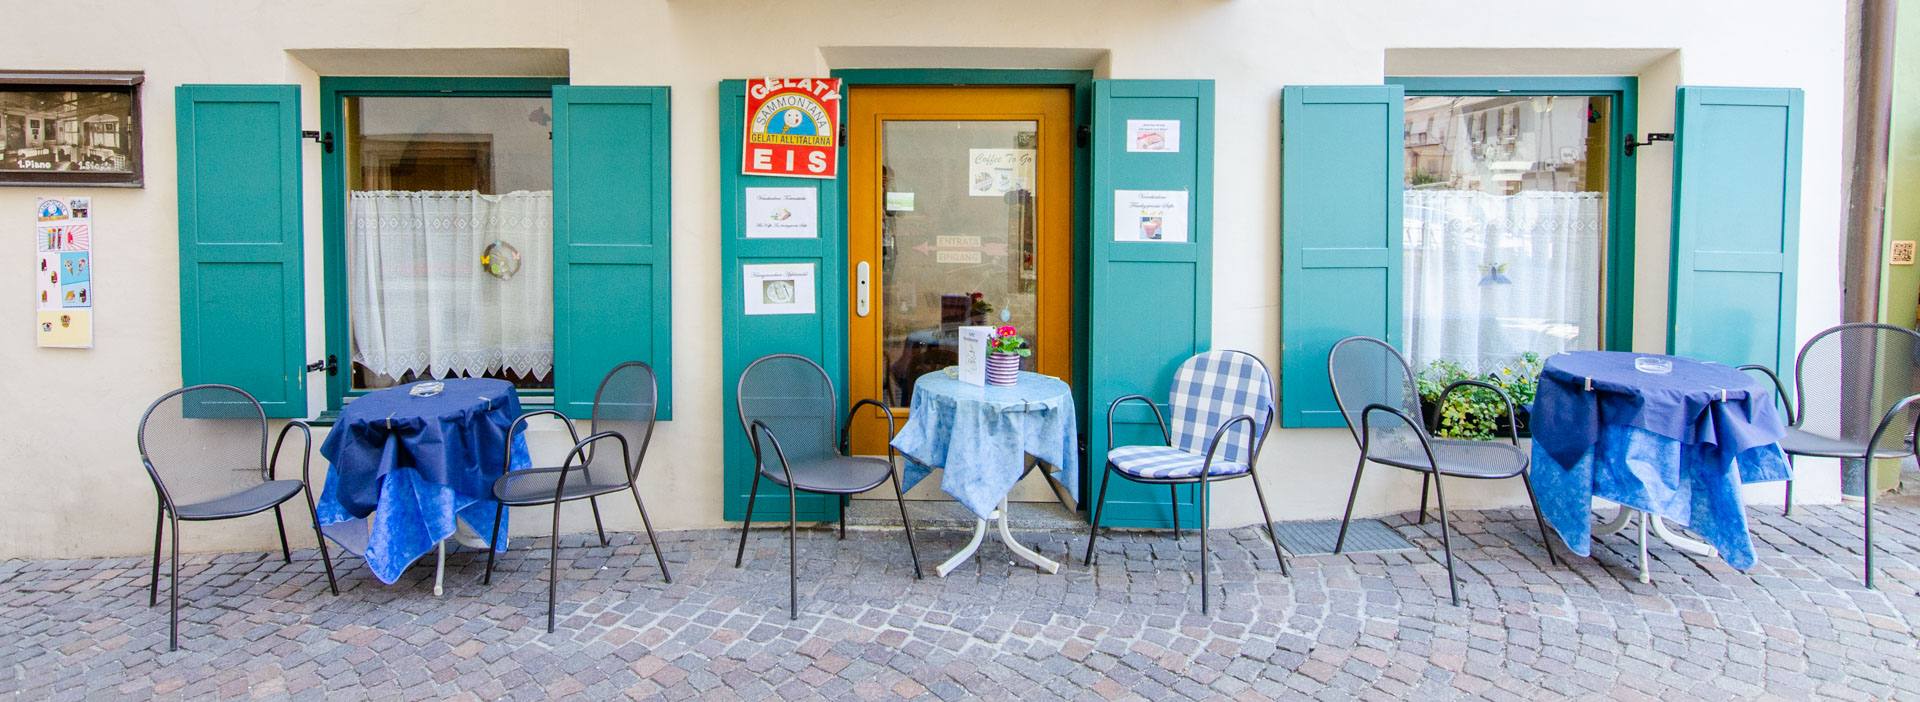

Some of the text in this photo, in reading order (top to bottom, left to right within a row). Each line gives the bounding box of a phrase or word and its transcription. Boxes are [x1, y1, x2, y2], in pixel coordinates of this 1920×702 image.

[756, 95, 827, 128] SAMMONTANA
[751, 133, 831, 146] GELATI ALL'ITALIANA
[17, 159, 52, 169] 1.Piano
[753, 148, 827, 173] EIS
[975, 152, 1032, 166] Coffee To Go
[938, 237, 980, 248] ENTRATA
[938, 252, 980, 262] EINGANG
